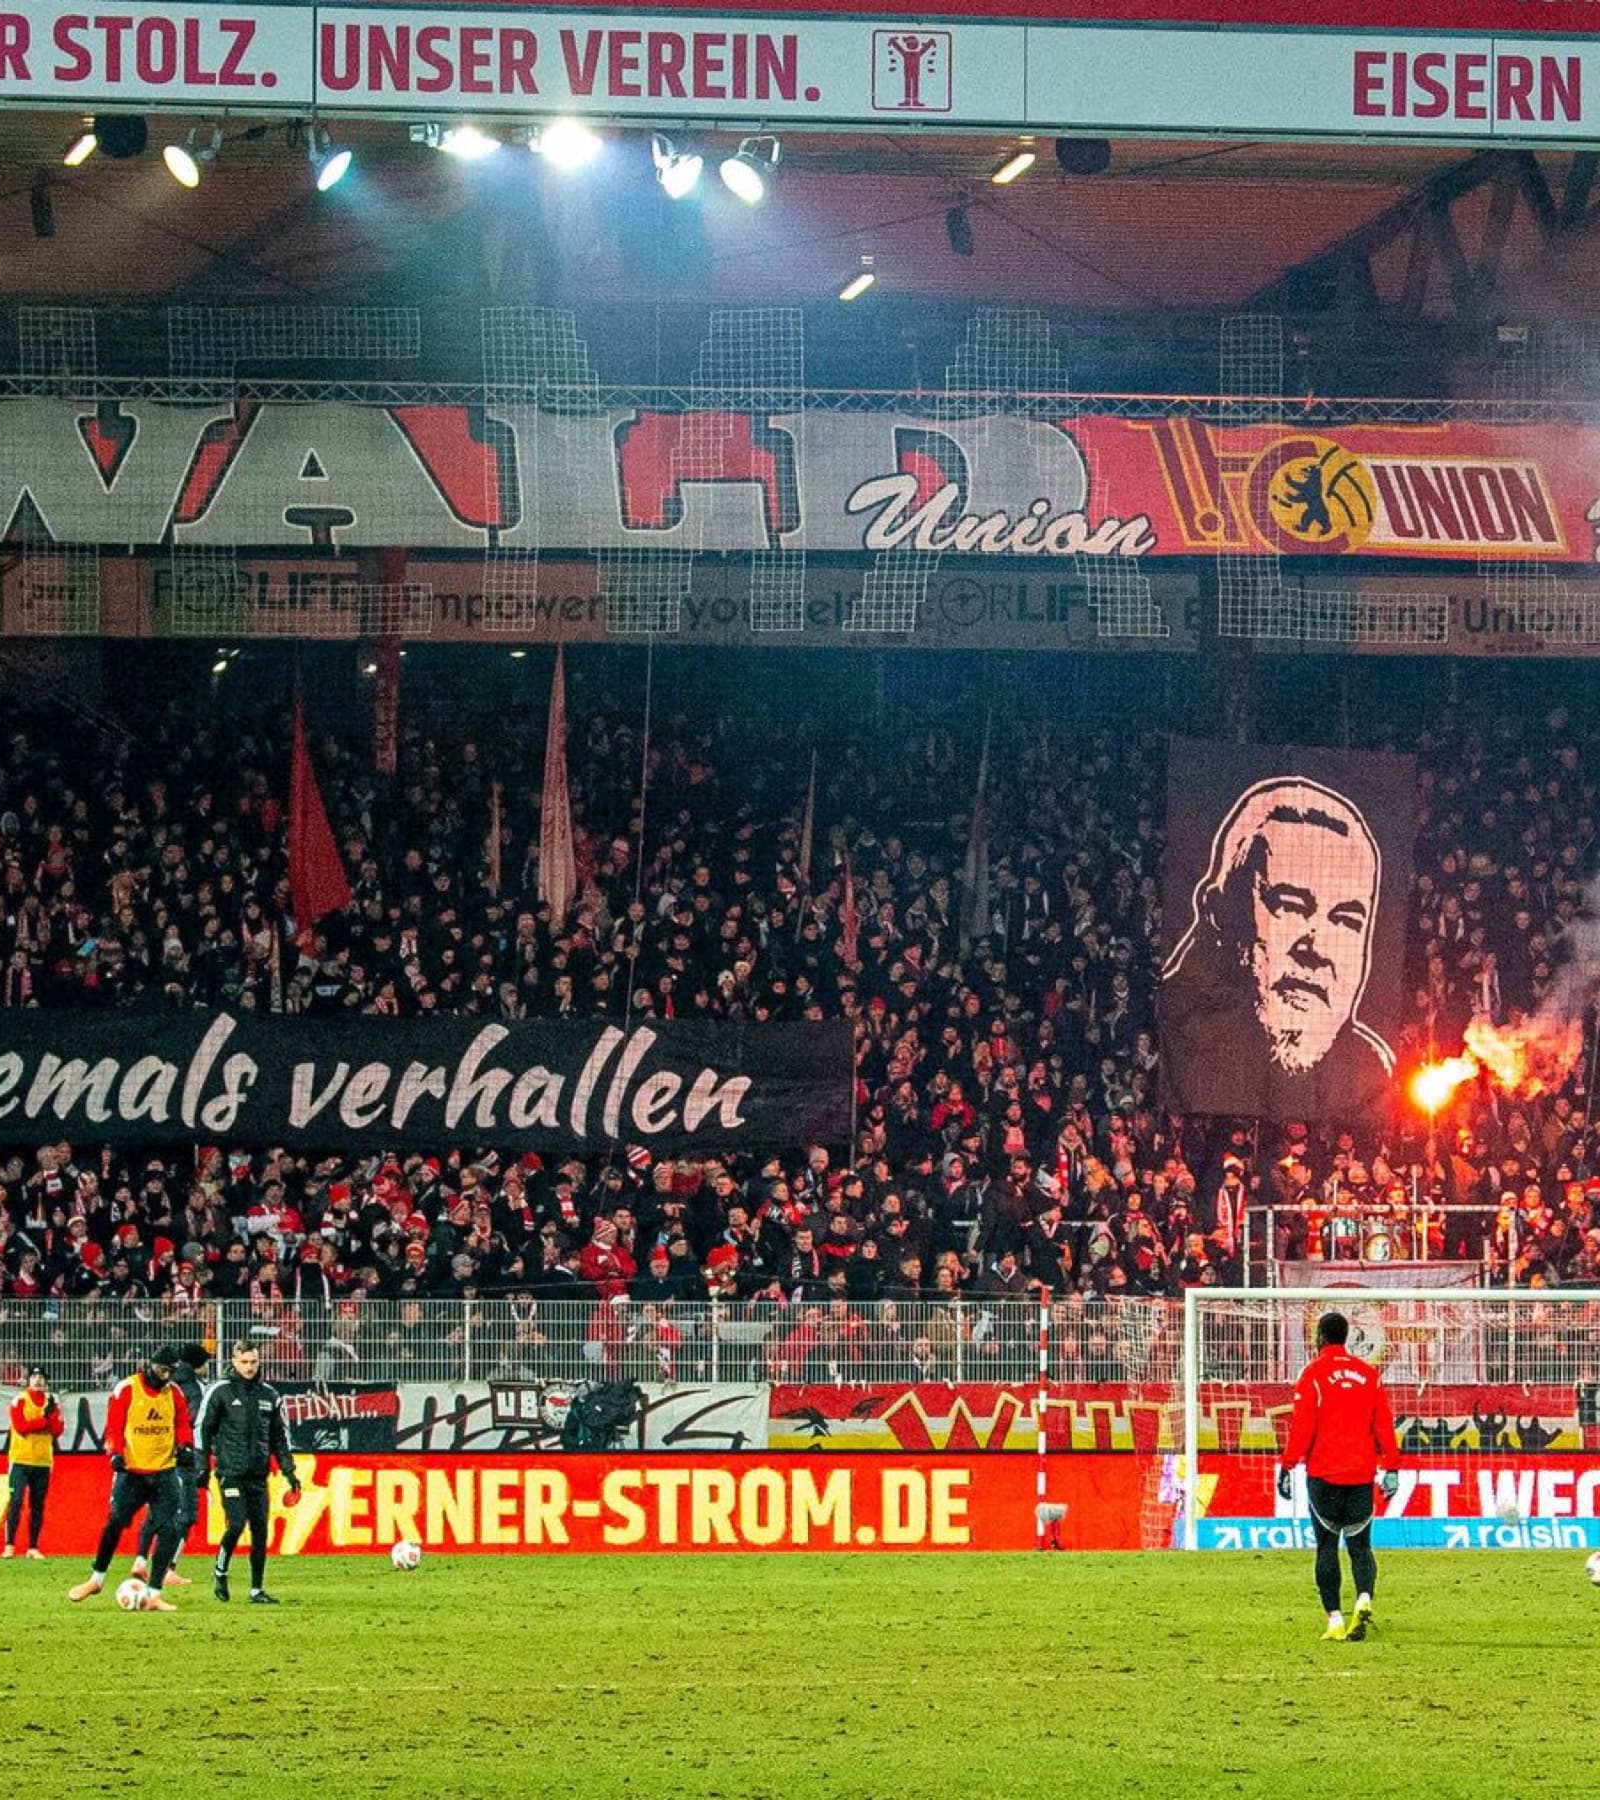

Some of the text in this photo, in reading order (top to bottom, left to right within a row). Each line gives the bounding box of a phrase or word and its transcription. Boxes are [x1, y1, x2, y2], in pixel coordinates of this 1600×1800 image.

[53, 14, 277, 88] STOLZ.
[319, 22, 538, 95] UNSER
[558, 28, 821, 103] VEREIN.
[1353, 50, 1582, 121] EISERN
[849, 475, 1158, 557] Union
[1372, 464, 1558, 544] UNION
[289, 1022, 753, 1140] verhallen
[1249, 1516, 1318, 1549] rais
[1477, 1516, 1588, 1549] raisin
